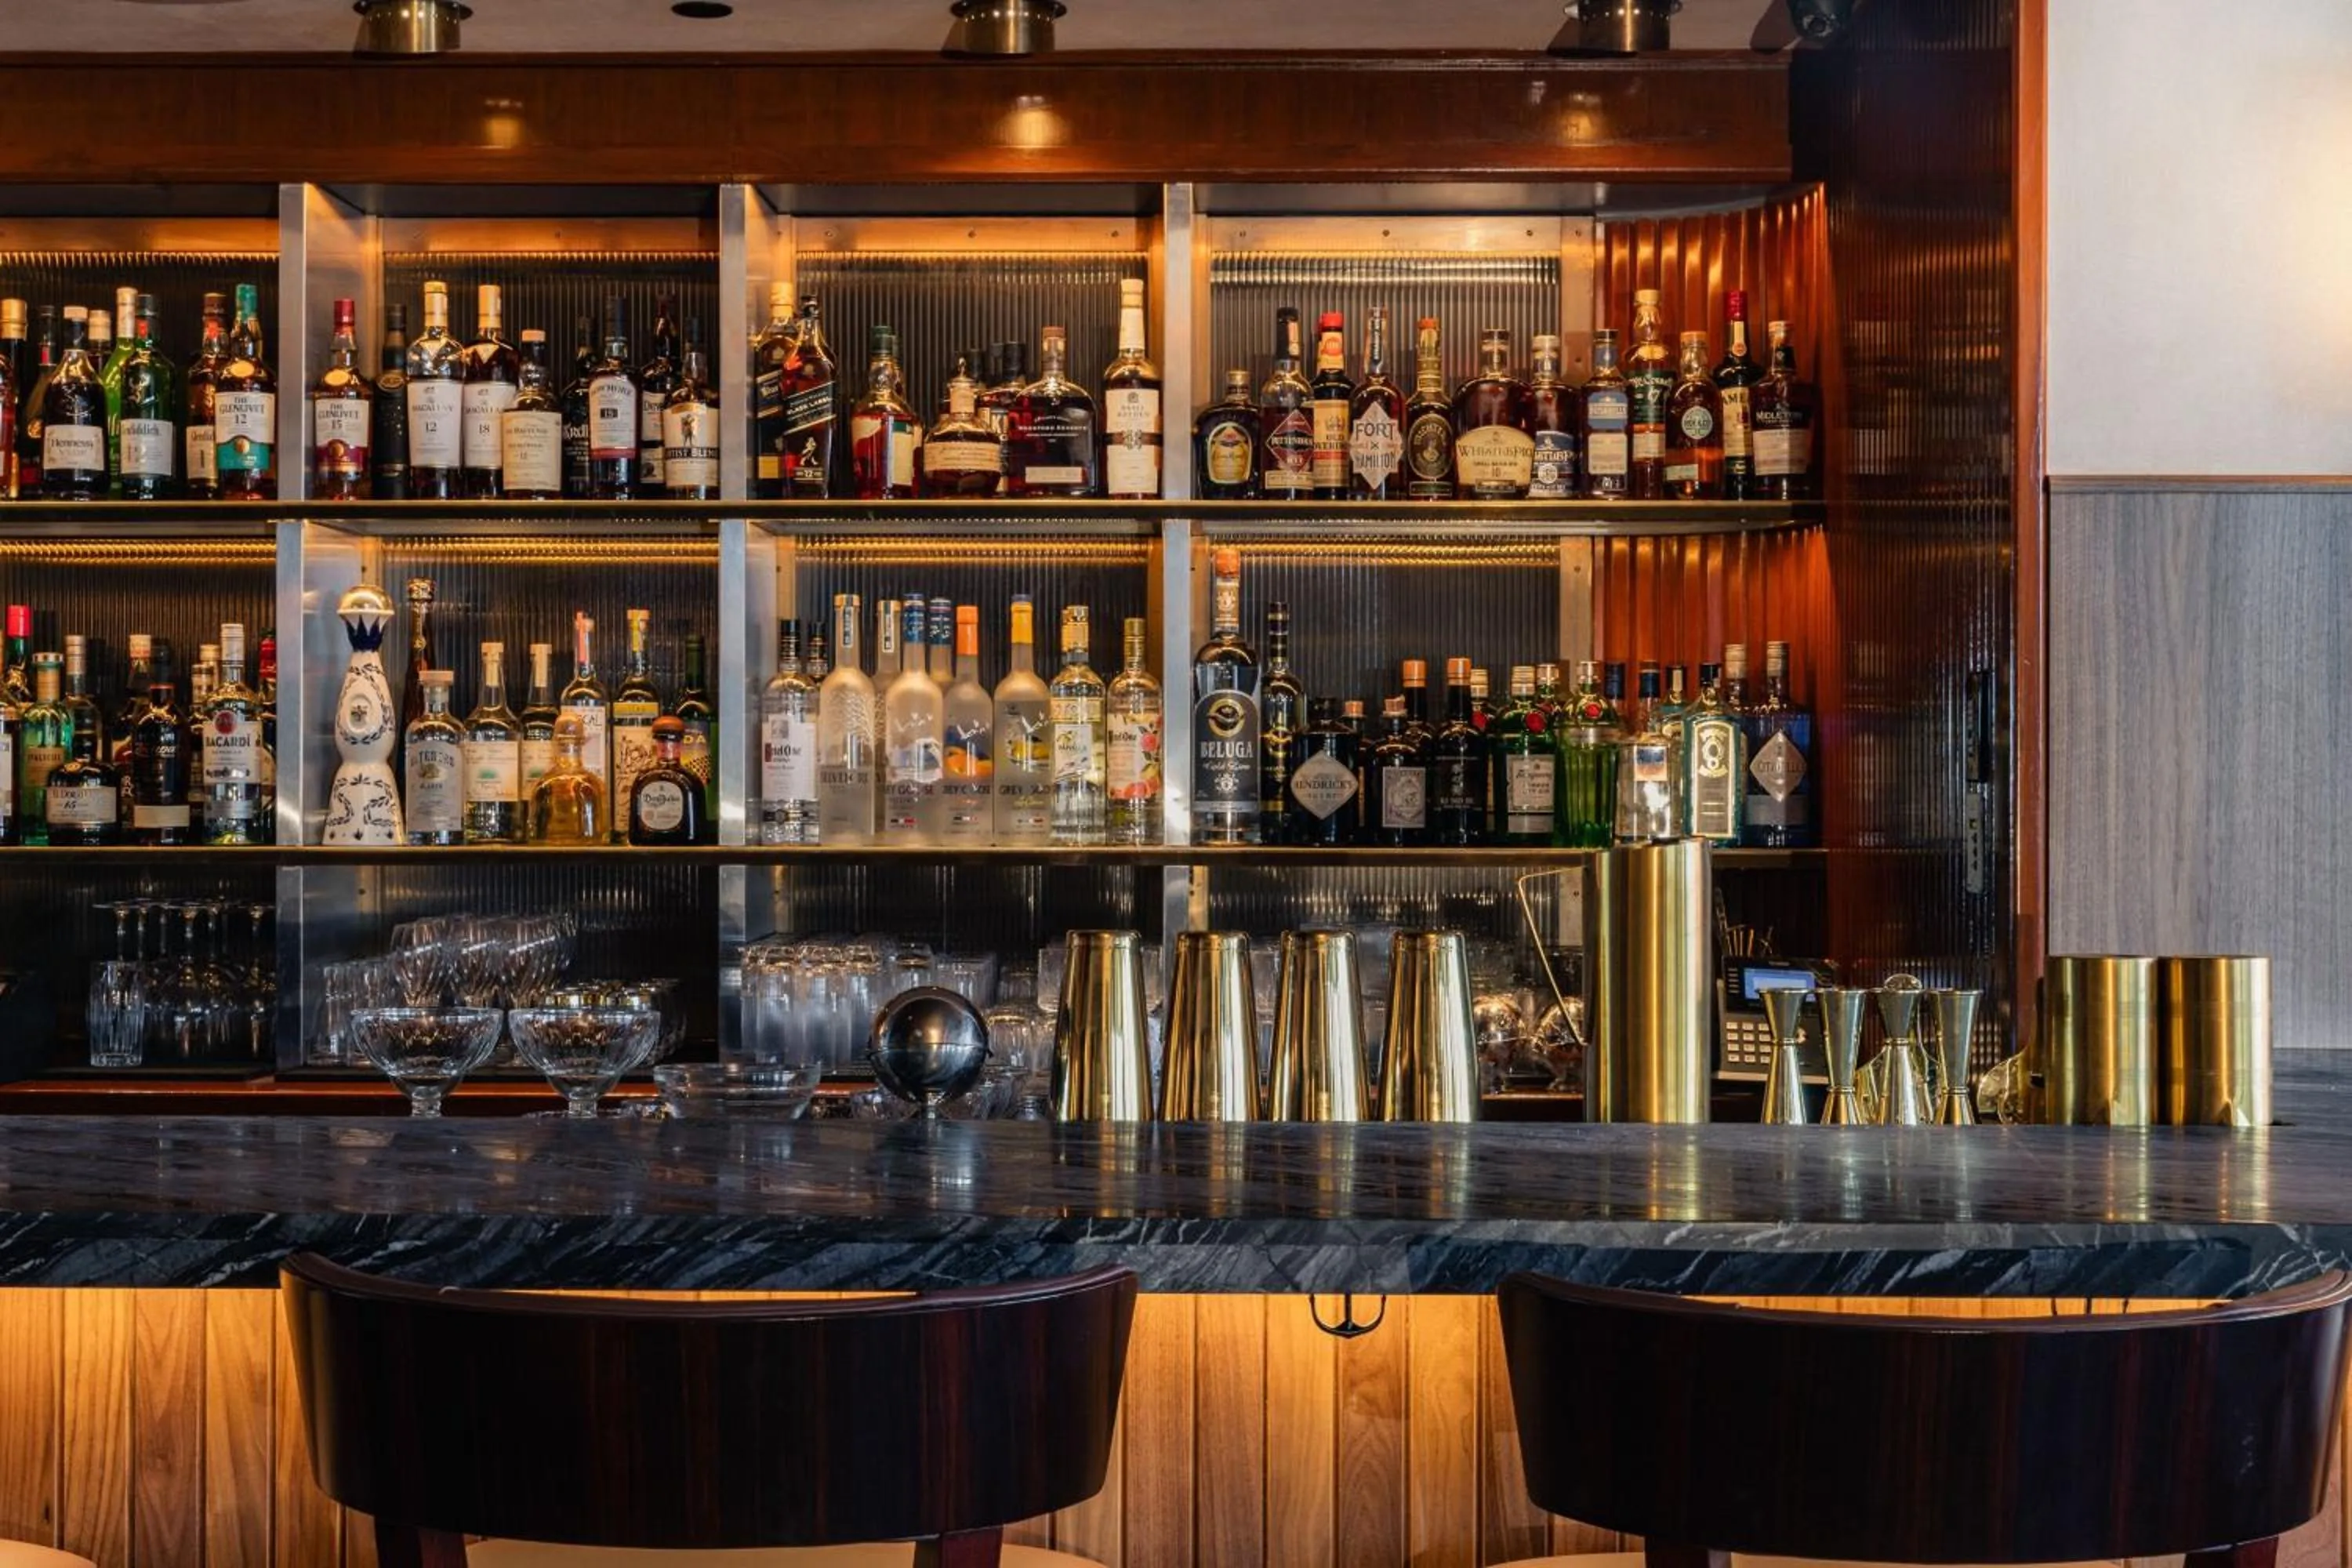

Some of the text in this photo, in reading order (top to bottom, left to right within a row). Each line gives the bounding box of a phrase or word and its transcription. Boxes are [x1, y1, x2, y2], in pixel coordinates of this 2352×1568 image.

[220, 405, 264, 414] GLENLIVET
[318, 410, 358, 419] GLENLIVET
[464, 405, 503, 414] MACALLA
[235, 414, 247, 424] 12
[331, 419, 343, 430] 15
[426, 423, 437, 432] 12
[479, 424, 490, 434] 18
[1356, 423, 1396, 442] FORT
[51, 438, 93, 449] Hennessy
[1457, 445, 1534, 459] WHISTLEPIG
[683, 735, 706, 744] DA
[1200, 741, 1254, 758] BELUGA
